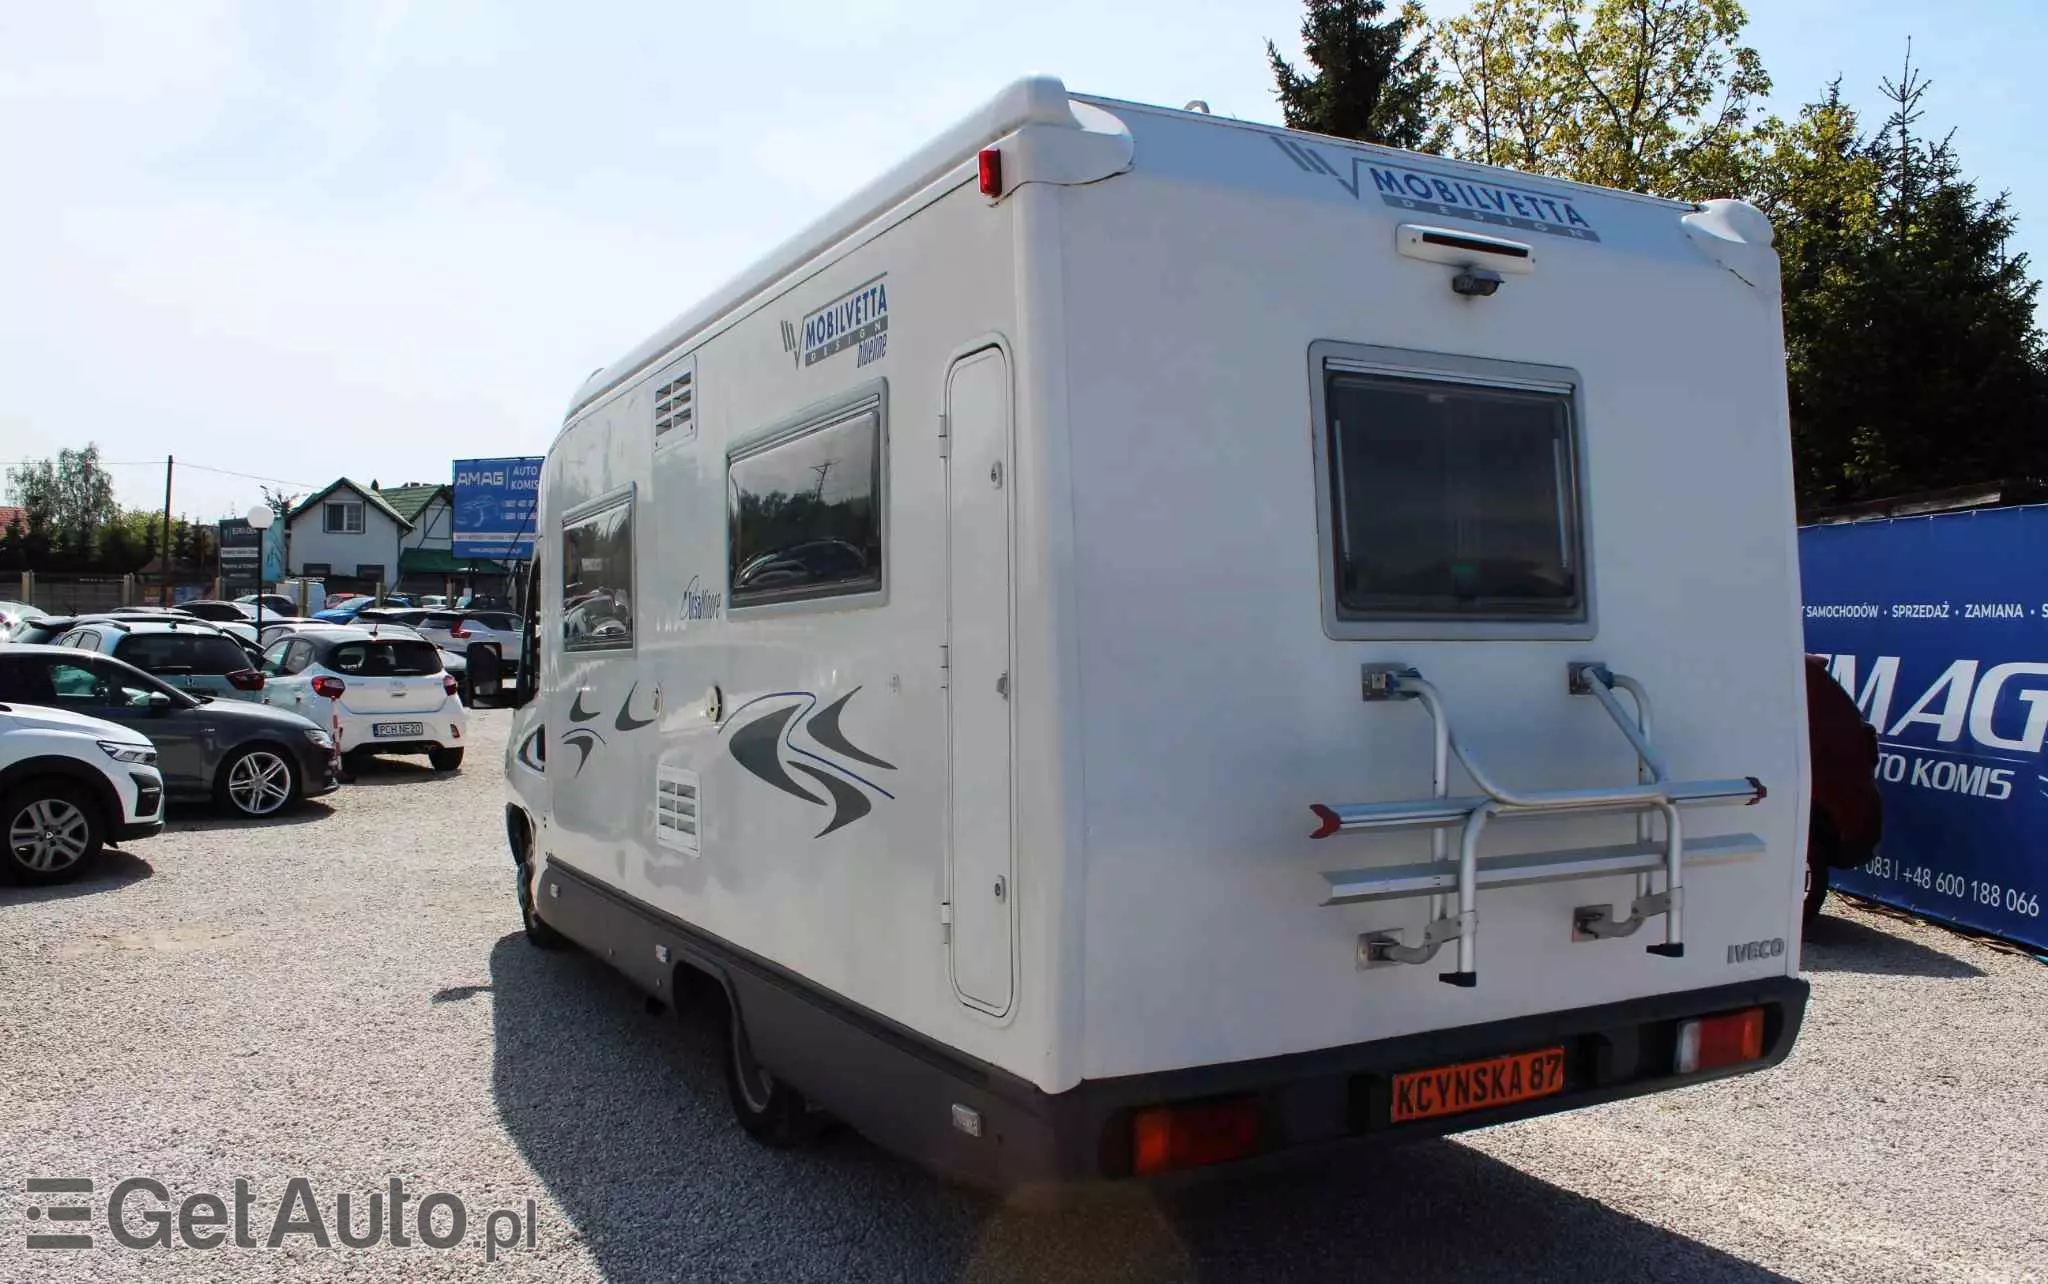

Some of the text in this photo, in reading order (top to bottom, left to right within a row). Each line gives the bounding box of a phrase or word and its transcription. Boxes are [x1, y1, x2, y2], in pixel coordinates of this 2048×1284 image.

[1370, 167, 1590, 228] MOBILVETTA
[1402, 200, 1585, 239] DESIGN
[805, 283, 888, 351] MOBILVETTA
[811, 320, 881, 361] DESIGN
[456, 471, 504, 487] AMAG
[511, 480, 539, 490] KOMIS
[512, 466, 537, 477] AUTO
[1806, 602, 1879, 618] SAMOCHODÓW
[1892, 601, 1949, 618] SPRZEDAŻ
[1964, 604, 2024, 618] ZAMIANA
[1806, 653, 2048, 753] MAG
[1874, 753, 2015, 800] TO KOMIS
[1903, 866, 1931, 889] +48
[1936, 872, 1965, 898] 600
[1971, 880, 2000, 907] 188
[2006, 889, 2039, 916] 066
[1727, 937, 1785, 964] IVECO
[1398, 1054, 1563, 1114] KCYNSKA 87
